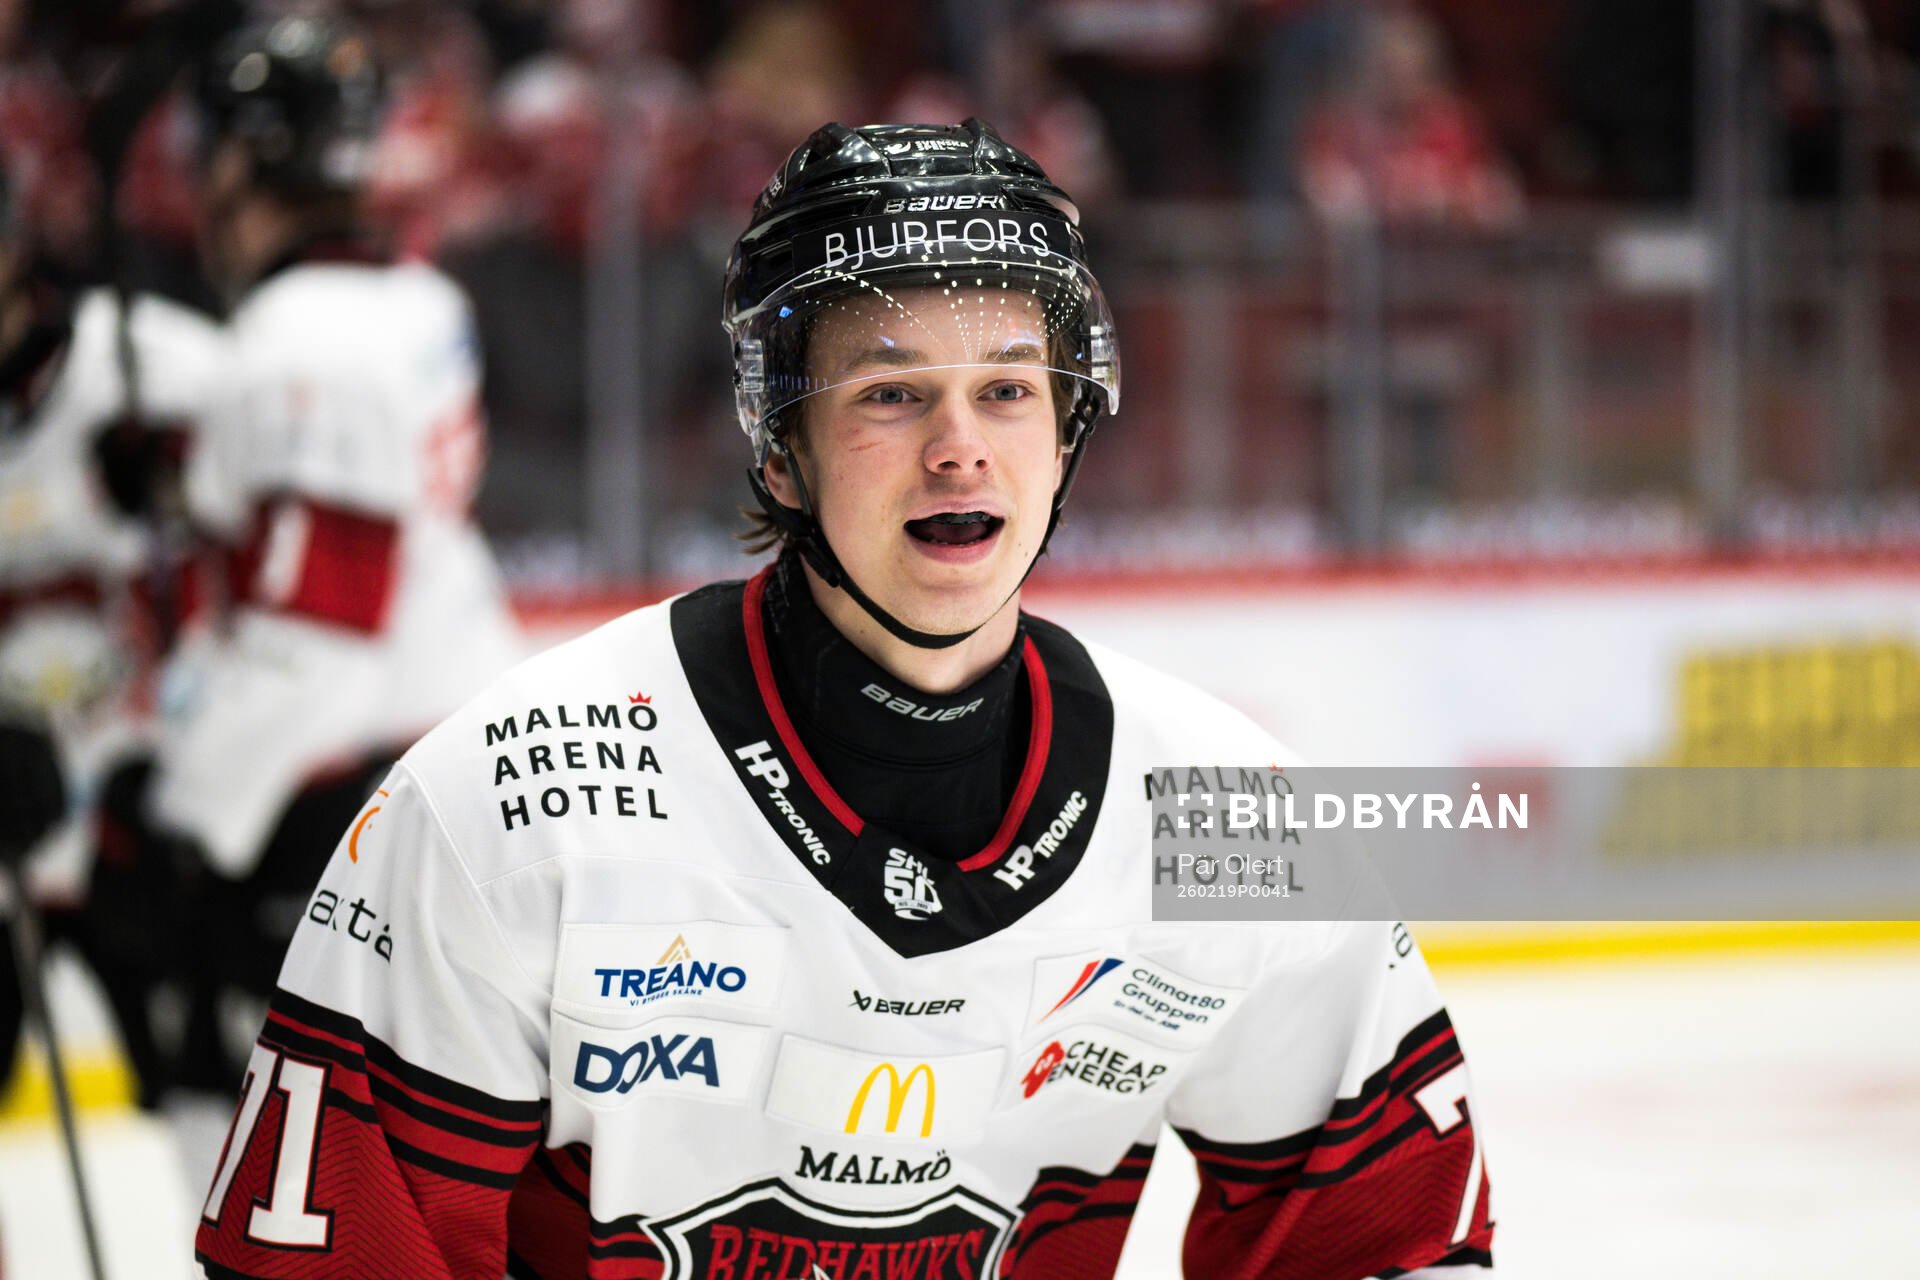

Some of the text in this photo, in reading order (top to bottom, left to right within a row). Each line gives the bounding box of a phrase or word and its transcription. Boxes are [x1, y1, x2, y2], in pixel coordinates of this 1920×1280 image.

[824, 218, 1051, 270] BJURFORS
[860, 682, 984, 722] BAUER
[494, 741, 663, 786] ARENA
[500, 785, 668, 831] HOTEL
[594, 961, 747, 998] TREANO
[1131, 968, 1226, 1011] Climat80
[874, 998, 966, 1016] BAUER
[1122, 982, 1209, 1025] Gruppen
[573, 1034, 720, 1094] DOXA
[1047, 1060, 1156, 1094] ENERGY
[1066, 1041, 1167, 1079] CHEAP
[795, 1145, 952, 1185] MALMÖ
[706, 1223, 987, 1280] REDHAWKS
